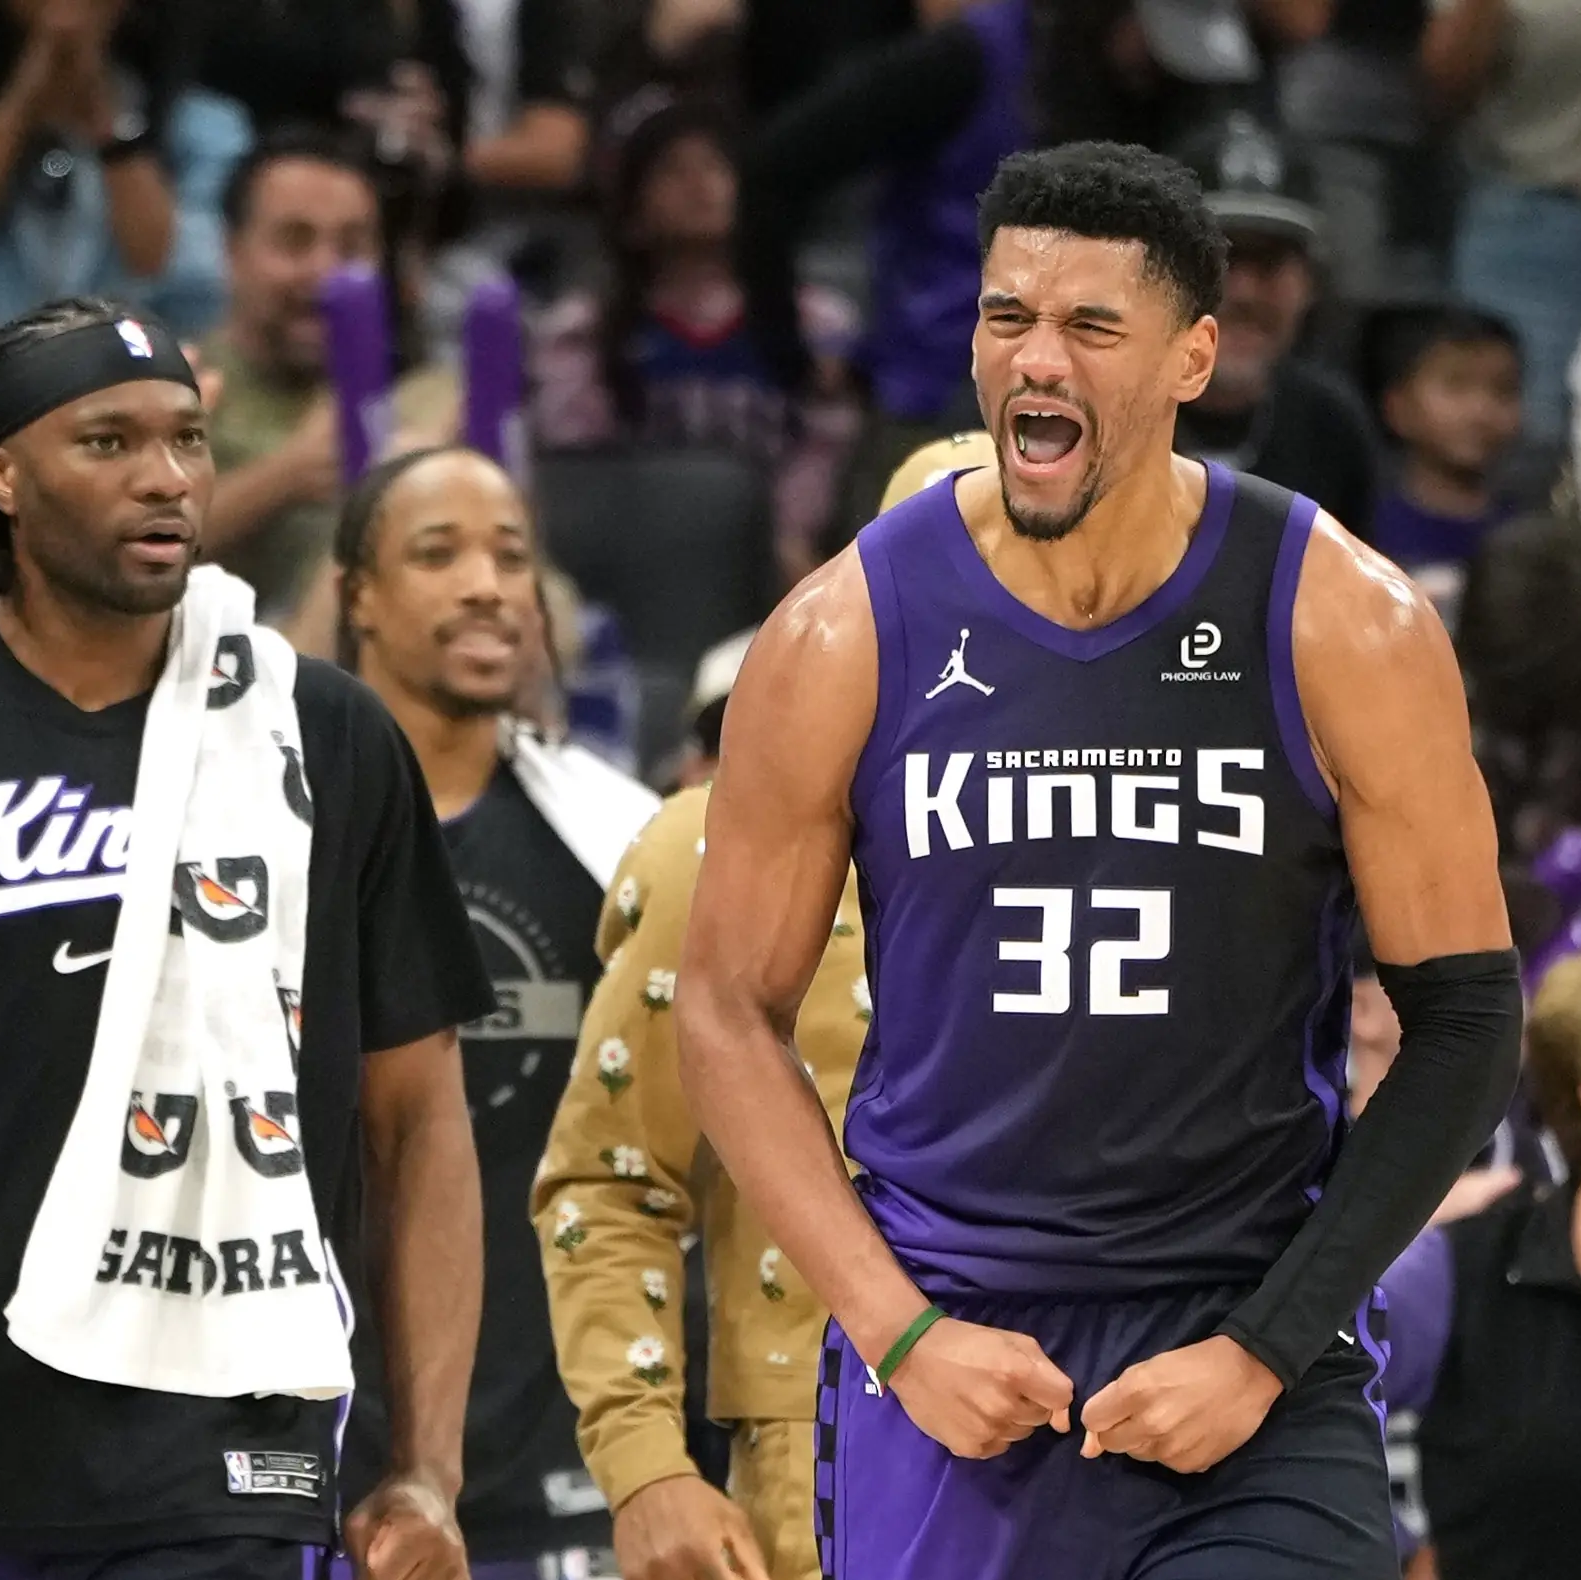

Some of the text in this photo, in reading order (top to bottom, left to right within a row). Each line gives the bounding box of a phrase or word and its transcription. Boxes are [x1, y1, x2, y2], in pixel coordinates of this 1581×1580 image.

[1160, 671, 1242, 682] PHOONG LAW
[985, 749, 1183, 769] SACRAMENTO
[992, 887, 1172, 1015] 32
